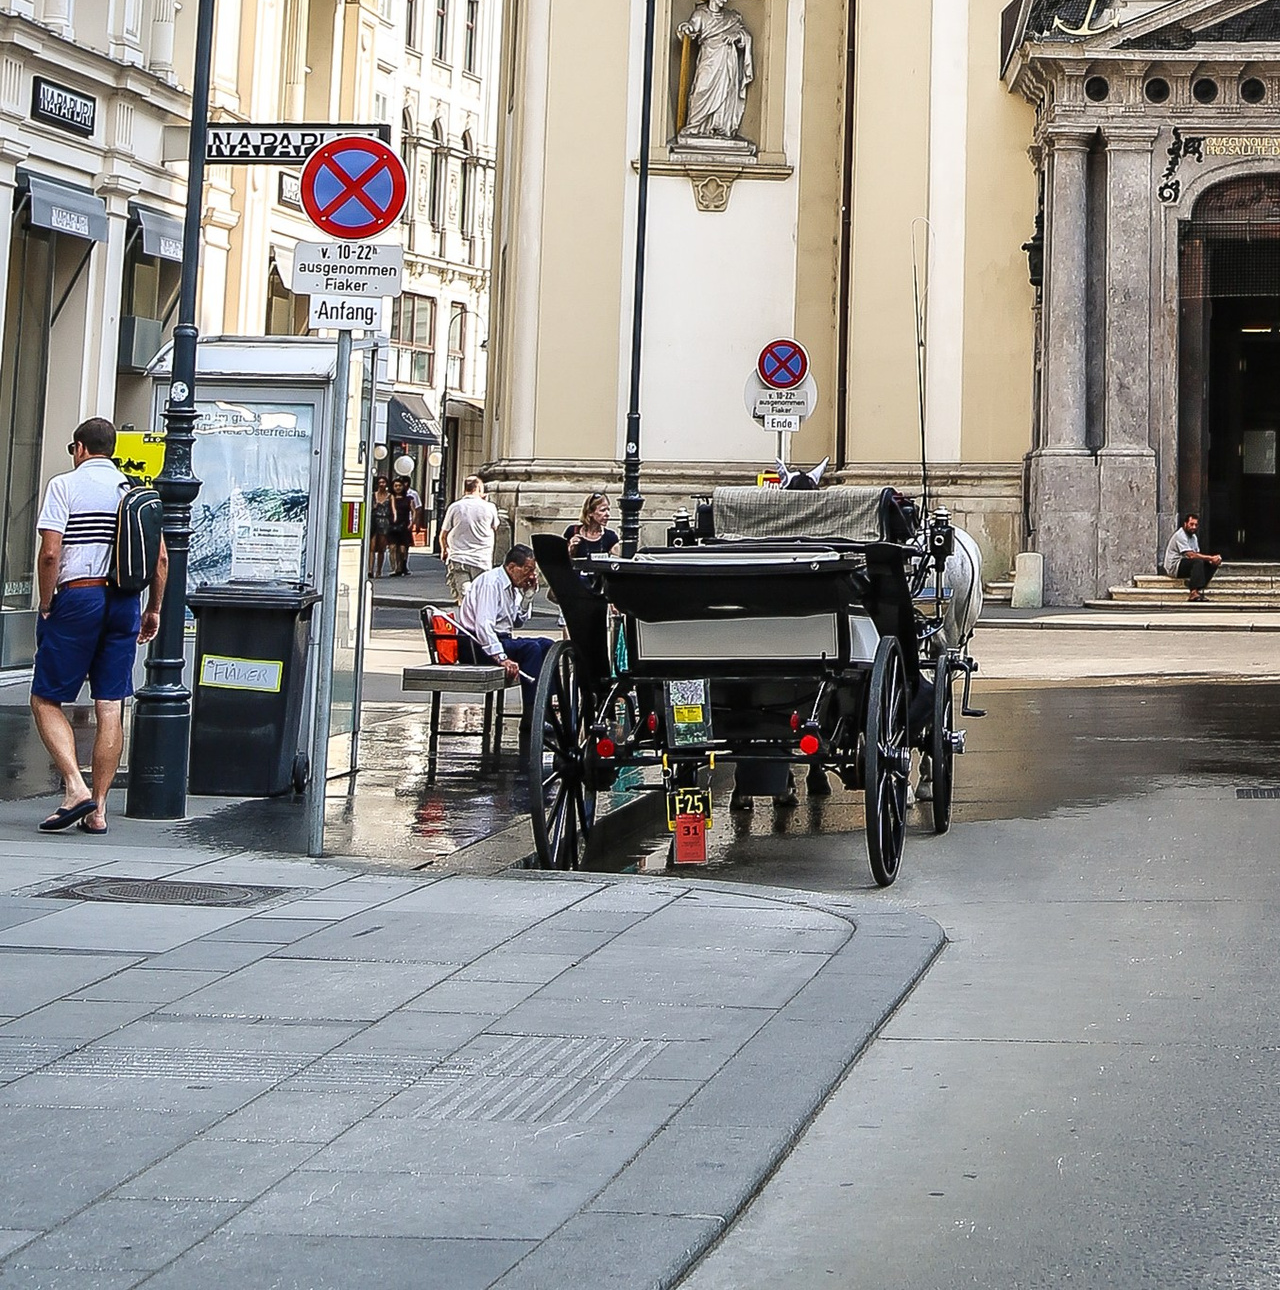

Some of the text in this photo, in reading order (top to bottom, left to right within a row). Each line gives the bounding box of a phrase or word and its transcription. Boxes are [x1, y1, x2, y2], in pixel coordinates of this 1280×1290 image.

[321, 247, 331, 259] v.
[299, 262, 397, 277] ausgenommen
[325, 278, 368, 292] Fiaker
[771, 419, 792, 428] Ende
[675, 795, 704, 815] F25
[683, 826, 700, 836] 31
